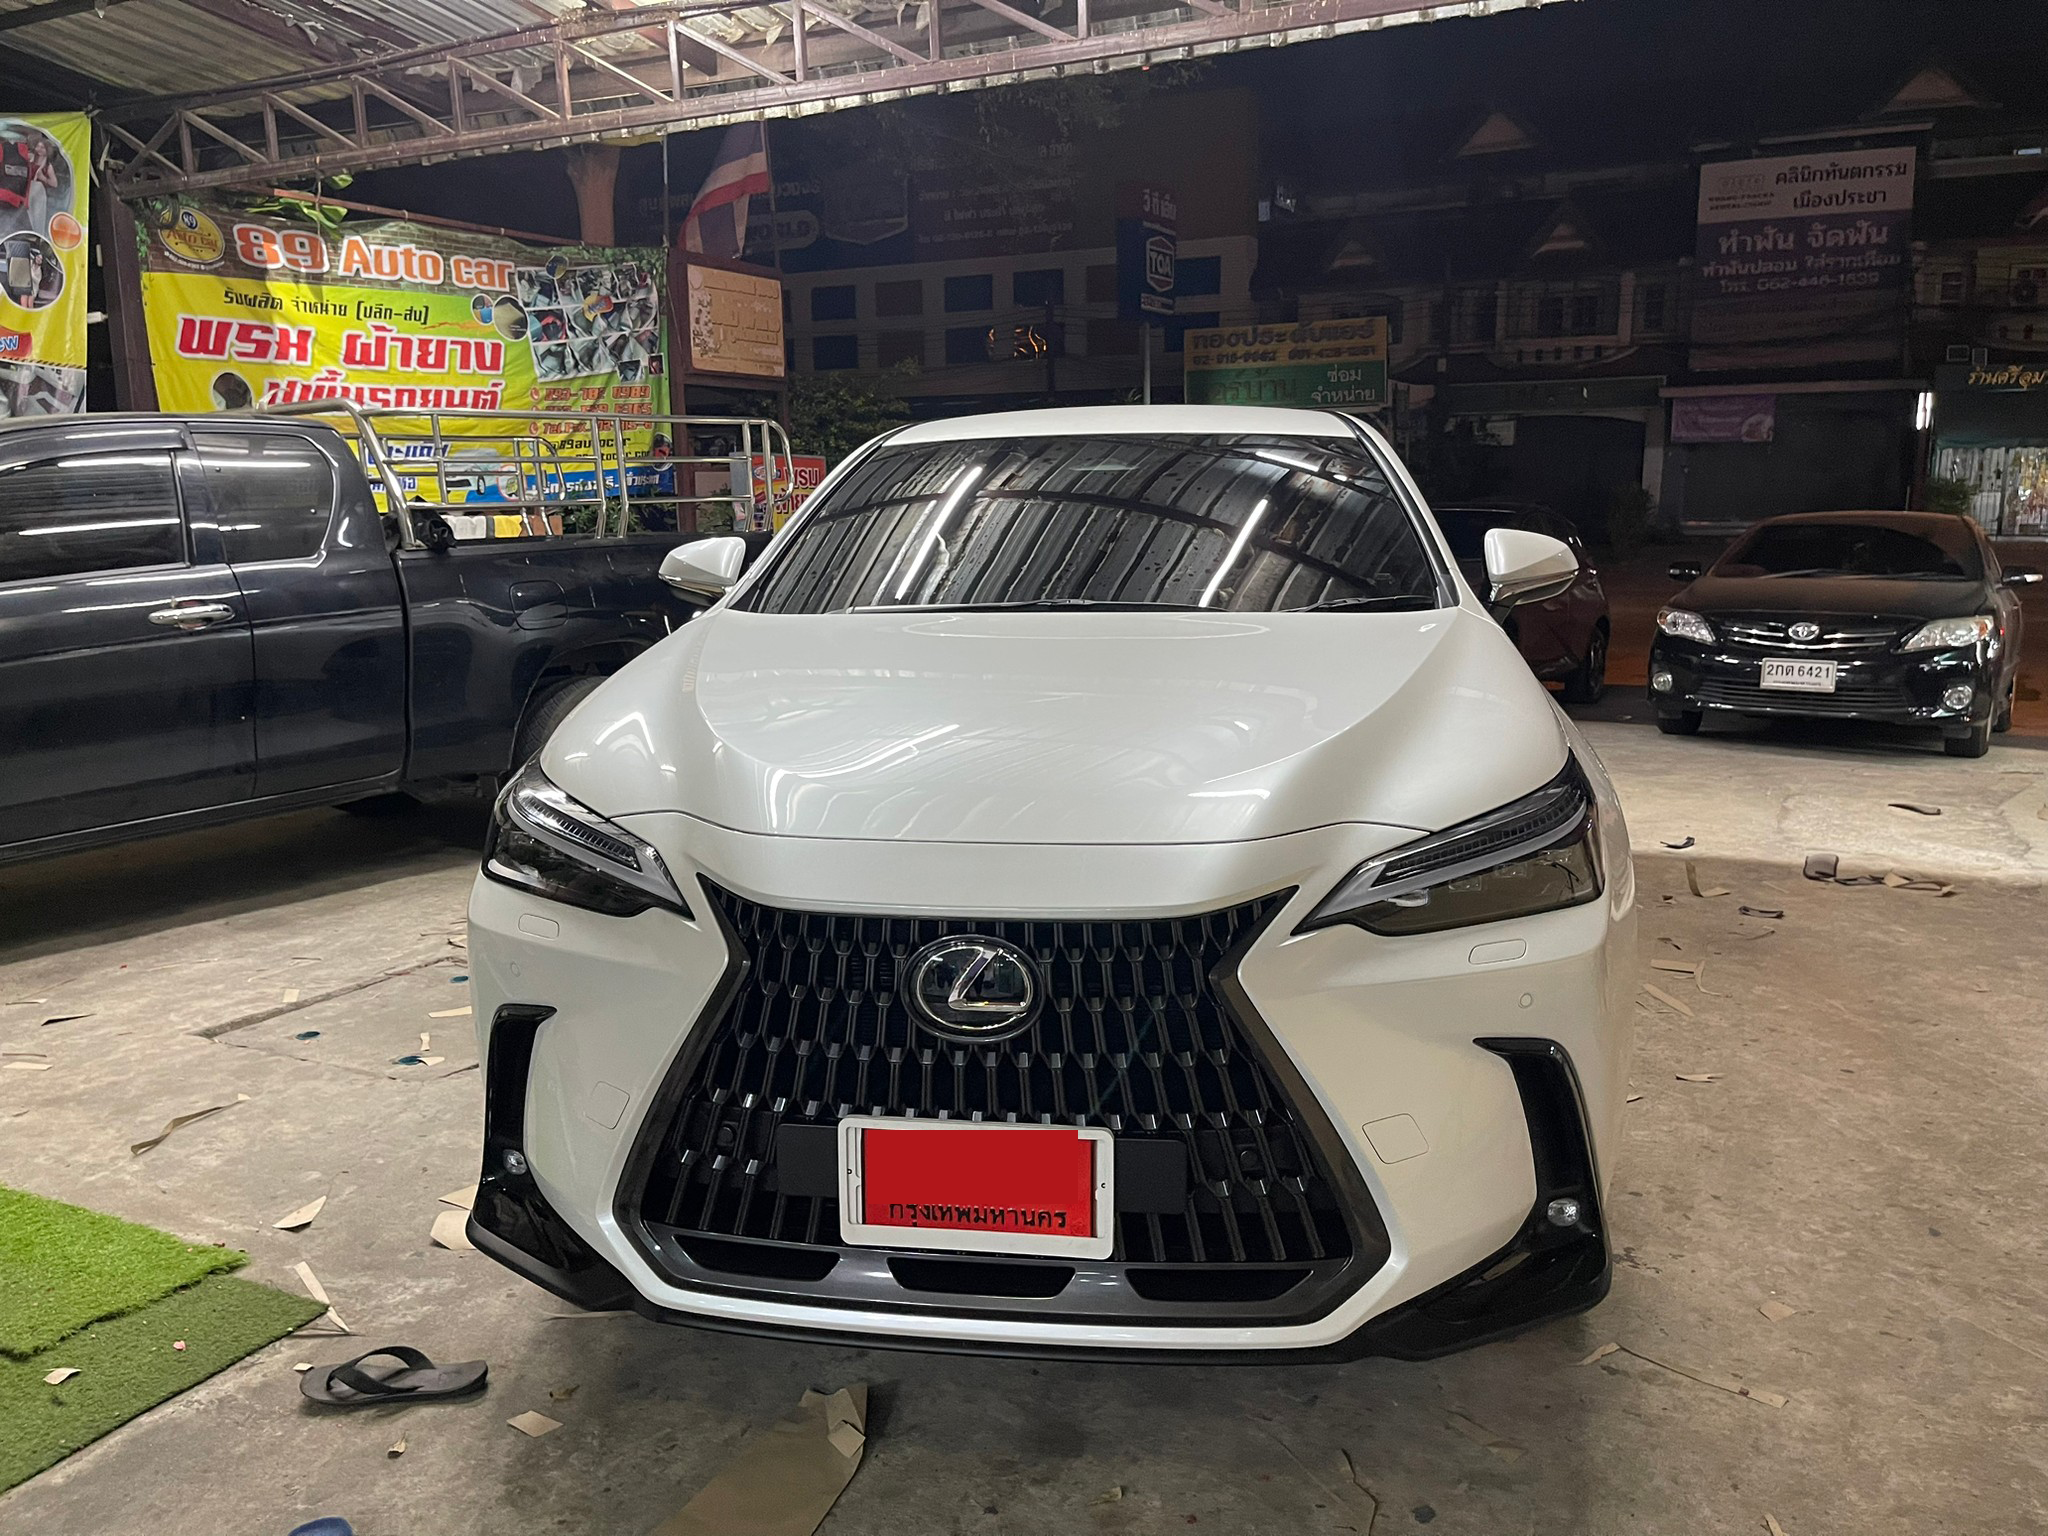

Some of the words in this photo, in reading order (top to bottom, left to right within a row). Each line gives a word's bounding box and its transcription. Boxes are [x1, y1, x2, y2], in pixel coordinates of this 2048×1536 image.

[1776, 161, 1907, 185] คลินิกทันตกรรม
[1793, 189, 1888, 209] เมืองประชา
[1718, 226, 1794, 254] ทำฟัน
[1806, 219, 1889, 248] จัดฟัน
[233, 222, 329, 274] 89
[338, 235, 443, 286] Auto
[450, 254, 514, 292] car
[1149, 250, 1173, 279] TOA
[223, 287, 283, 310] รับผลิต
[290, 296, 348, 317] จำหน่าย
[175, 313, 315, 366] พรม
[341, 321, 505, 375] ผ้ายาง
[1327, 363, 1361, 384] ซ่อม
[1309, 384, 1376, 405] จำหน่าย
[1797, 665, 1831, 679] 6421
[889, 1203, 1067, 1228] กรุงเทพมหานคร
